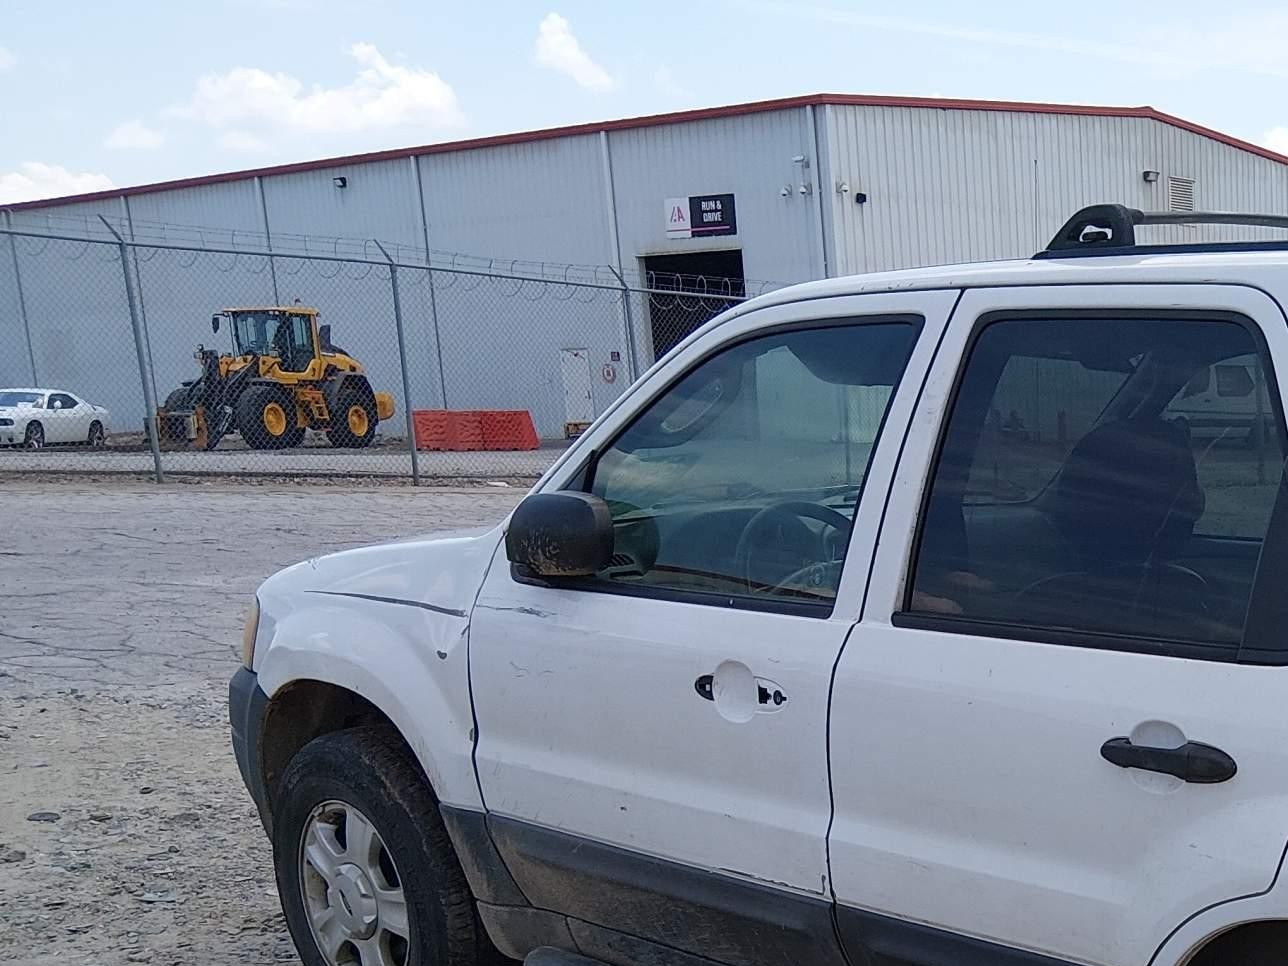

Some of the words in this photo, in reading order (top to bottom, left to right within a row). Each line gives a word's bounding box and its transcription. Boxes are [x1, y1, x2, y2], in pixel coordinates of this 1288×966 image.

[701, 201, 716, 211] RUN
[716, 200, 722, 210] &
[703, 212, 723, 223] DRIVE
